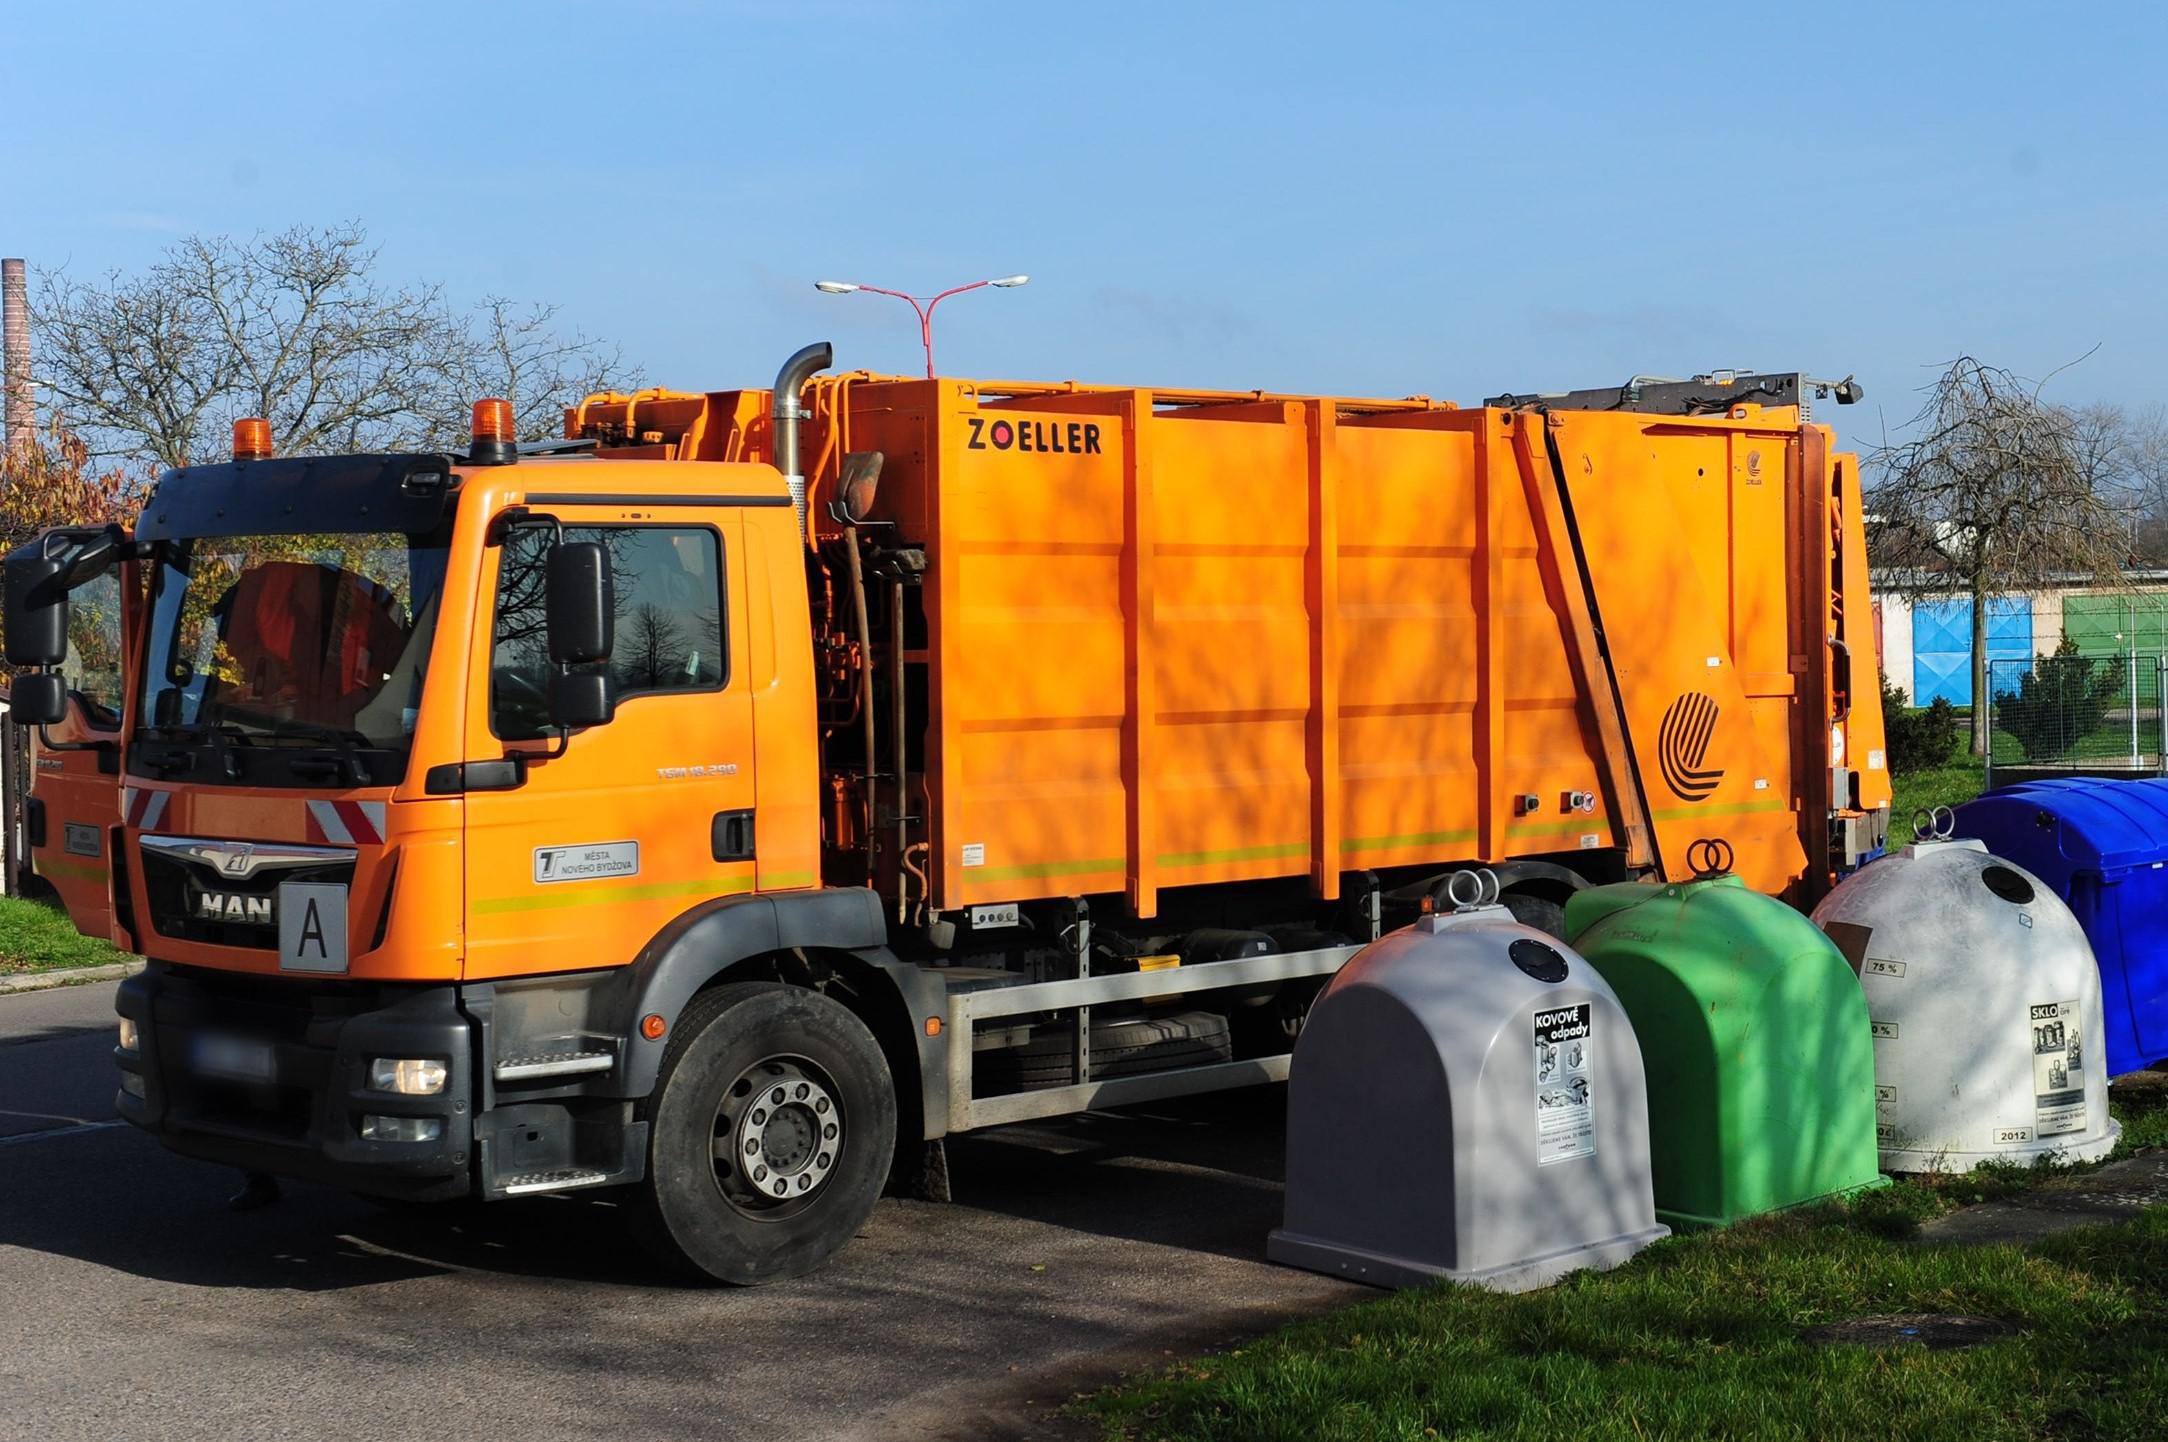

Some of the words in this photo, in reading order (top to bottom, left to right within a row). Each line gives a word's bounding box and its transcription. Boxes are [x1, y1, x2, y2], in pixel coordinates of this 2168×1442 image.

[968, 418, 1101, 454] ZOELLER
[202, 893, 271, 923] MAN
[297, 897, 327, 959] A
[1535, 1006, 1579, 1028] KOVOVÉ
[2032, 1006, 2058, 1019] SKLO
[1550, 1021, 1588, 1041] odpady
[2001, 1131, 2026, 1141] 2012
